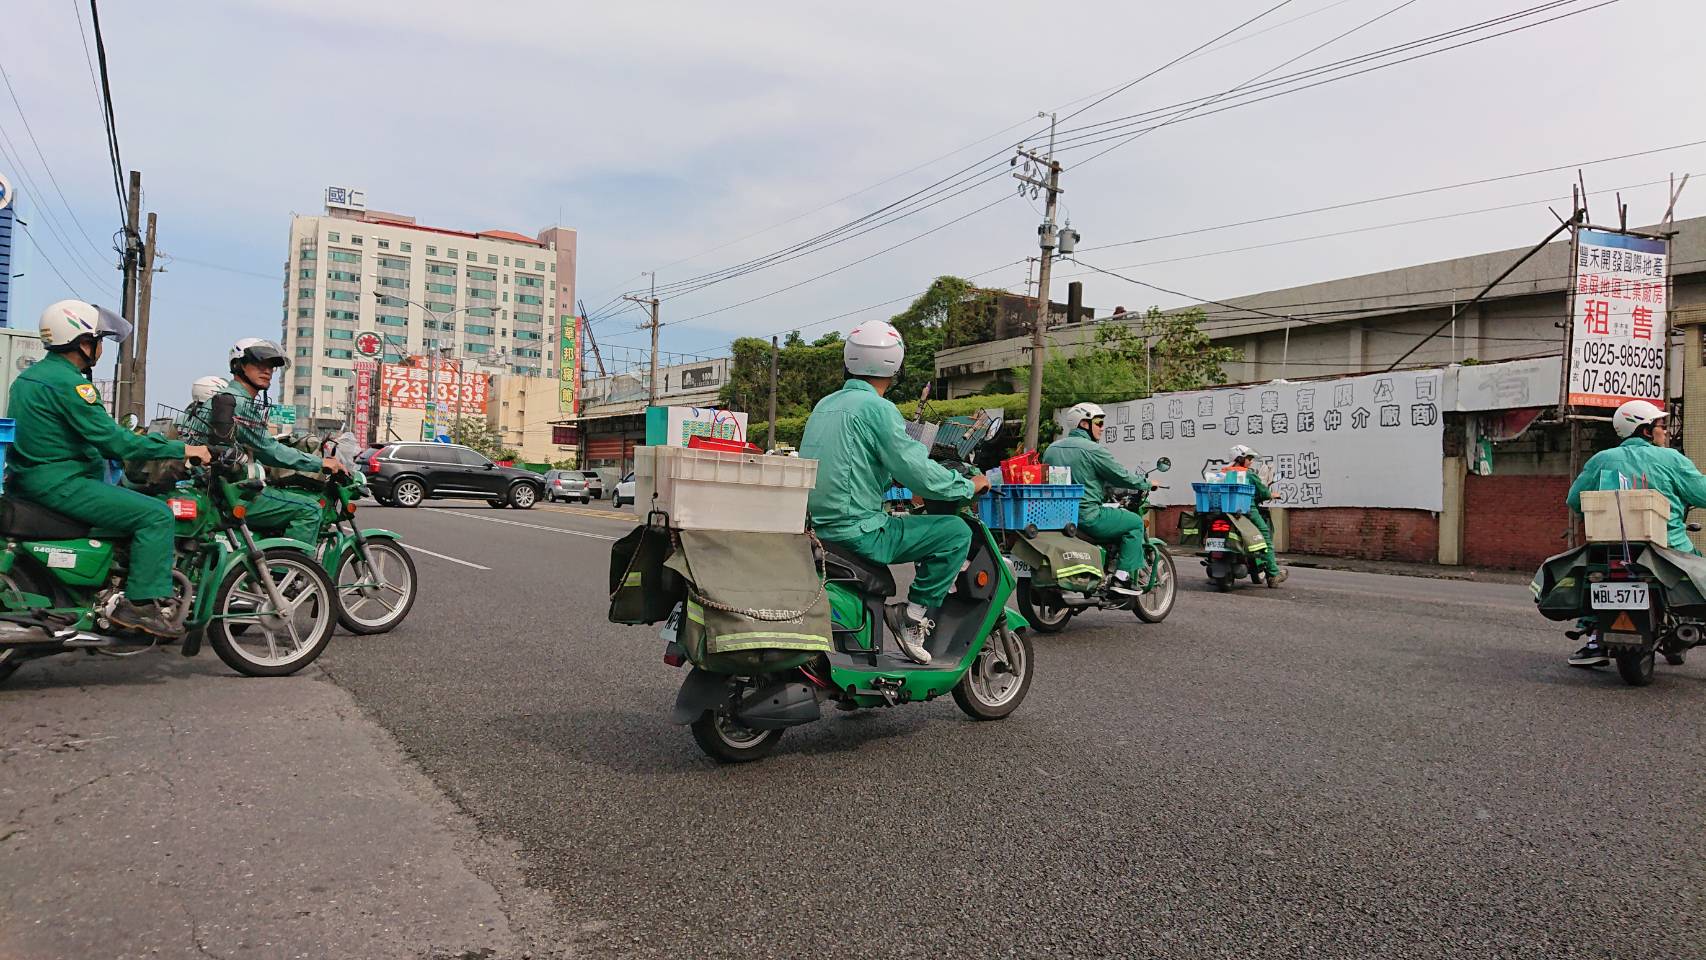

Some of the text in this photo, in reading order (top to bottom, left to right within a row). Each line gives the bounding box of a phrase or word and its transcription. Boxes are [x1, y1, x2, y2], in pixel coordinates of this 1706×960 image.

[328, 186, 364, 206] 國仁
[1579, 245, 1663, 277] 豐禾開發國際地產
[1578, 272, 1663, 304] 高屏地區工業廠房
[1583, 299, 1609, 335] 租
[1632, 304, 1653, 341] 售
[1583, 341, 1664, 370] 0925-985295
[1582, 368, 1661, 398] 07-862-0505
[1593, 589, 1646, 604] MBL-5717
